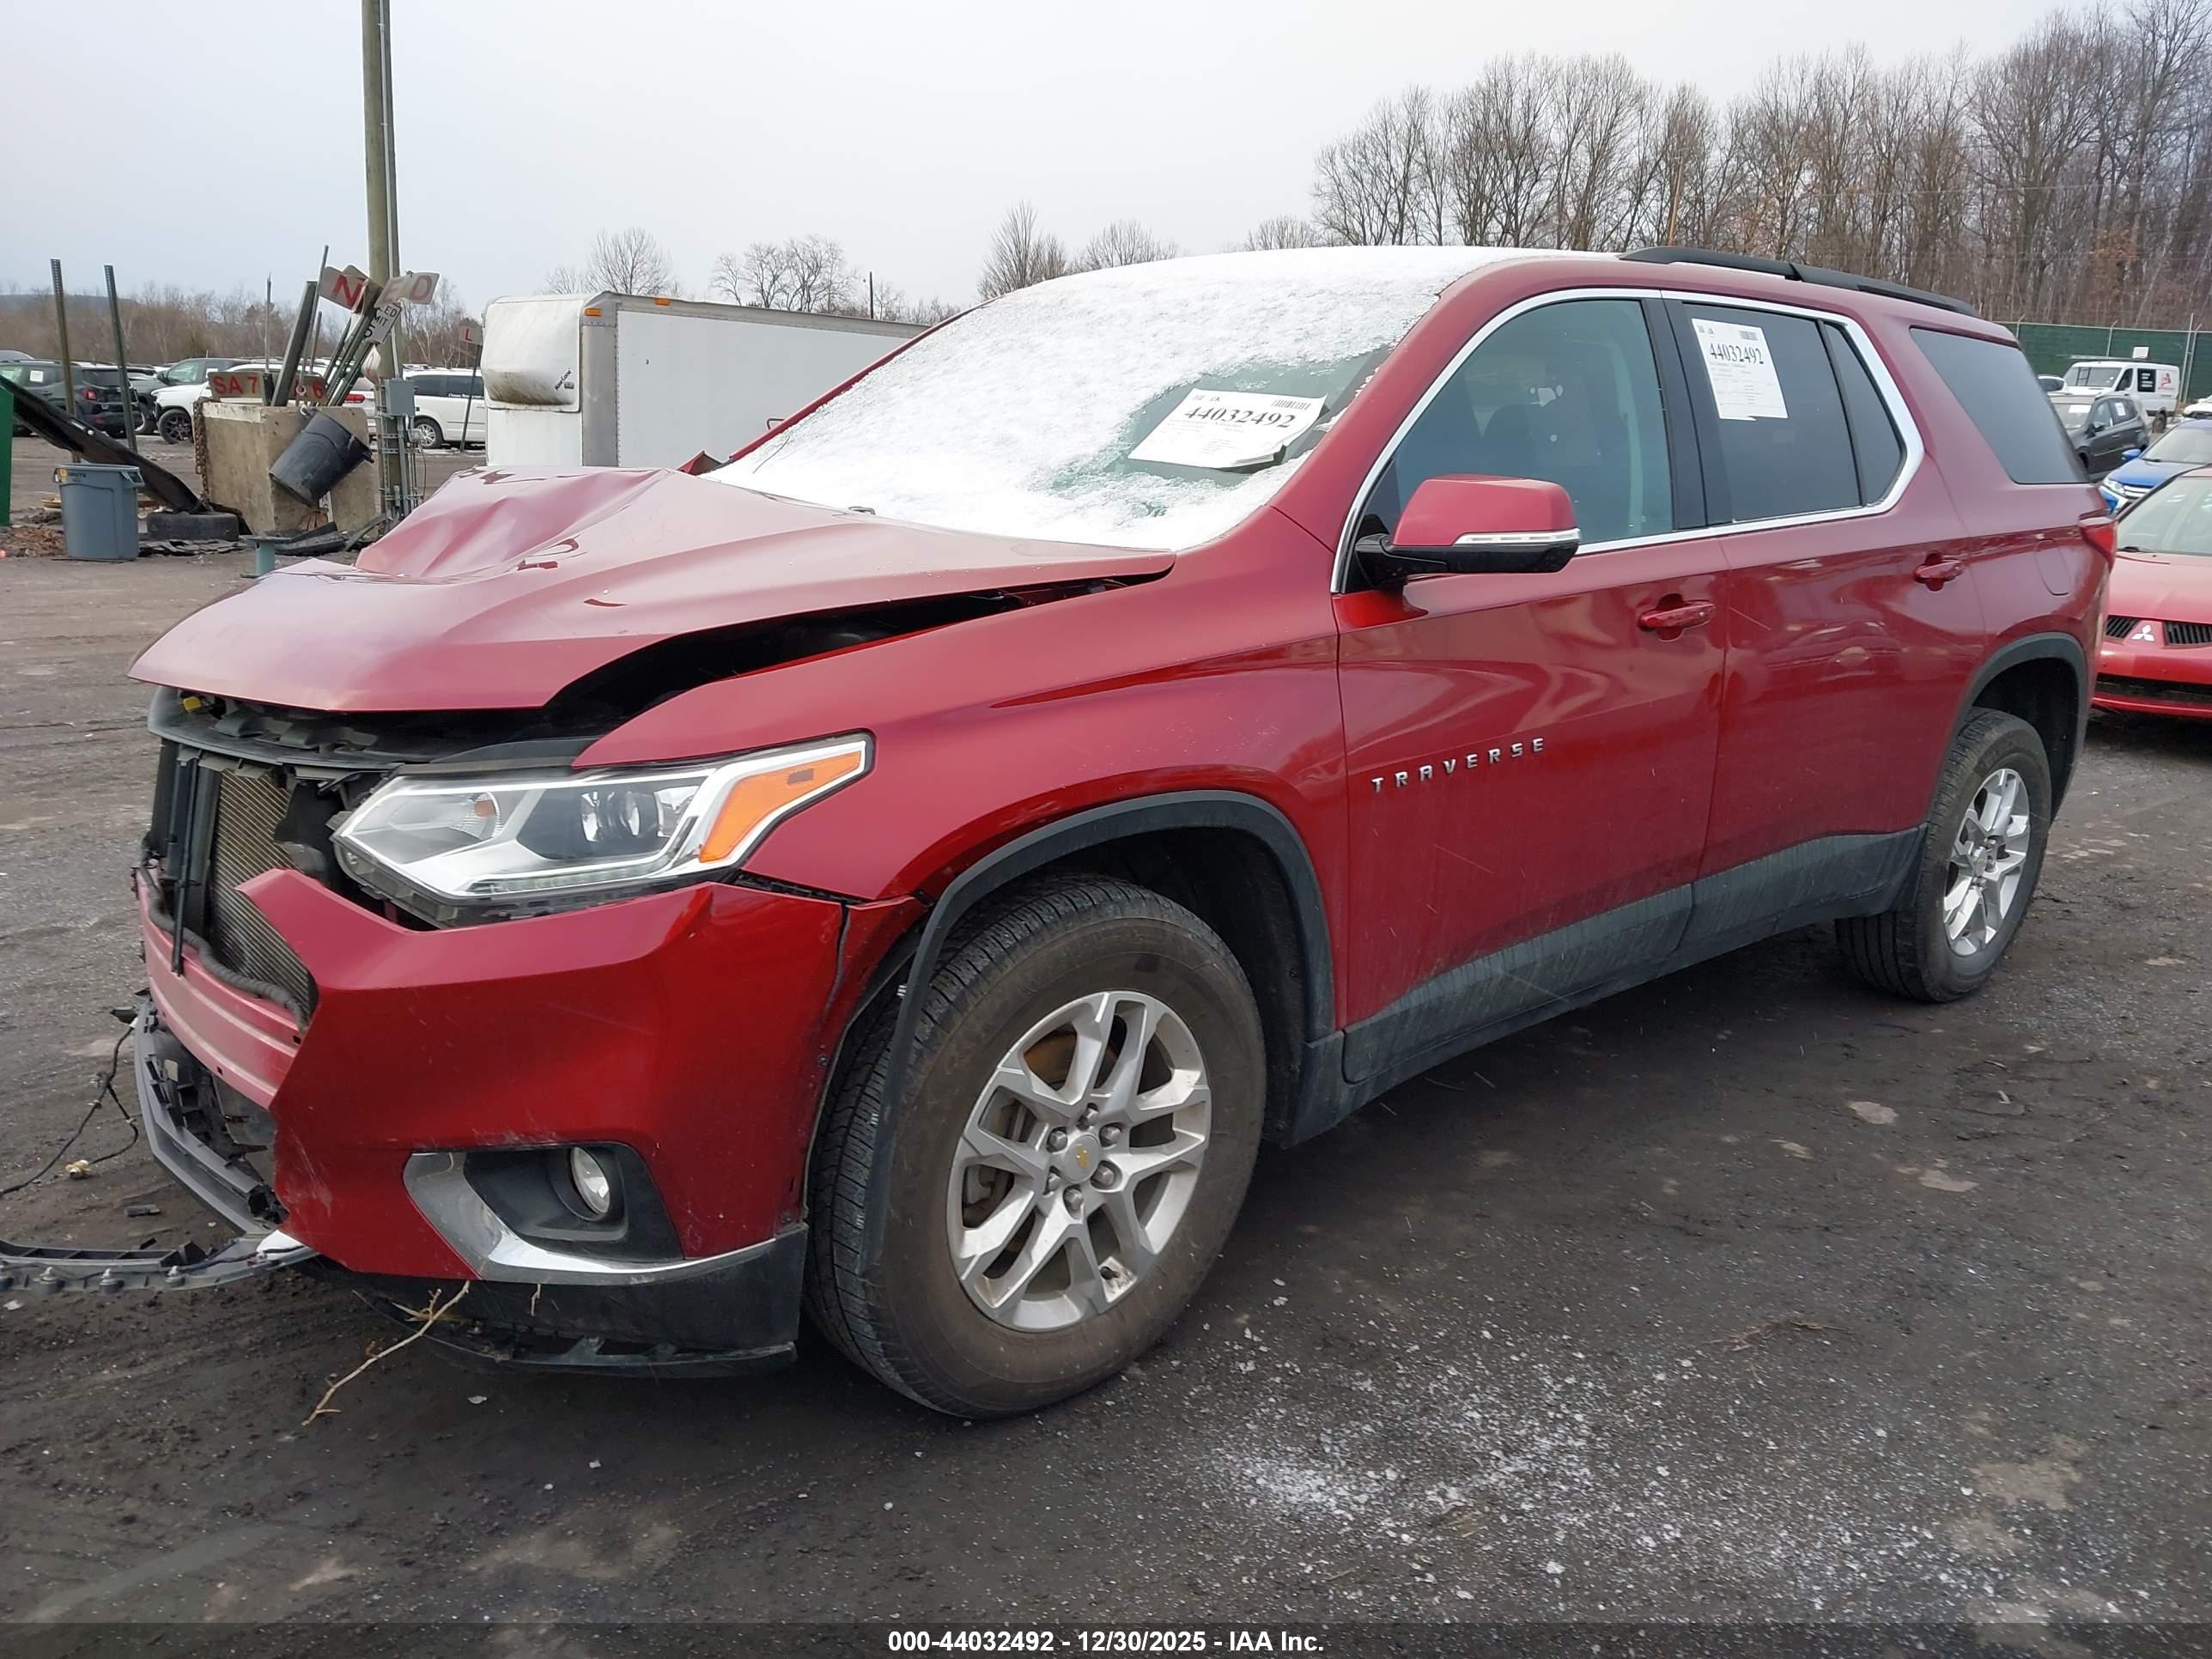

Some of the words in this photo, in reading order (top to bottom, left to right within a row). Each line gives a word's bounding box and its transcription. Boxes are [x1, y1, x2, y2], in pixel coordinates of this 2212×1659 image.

[1711, 343, 1764, 364] 44032492
[1184, 406, 1296, 428] 44032492
[1371, 738, 1545, 793] TRAVERSE
